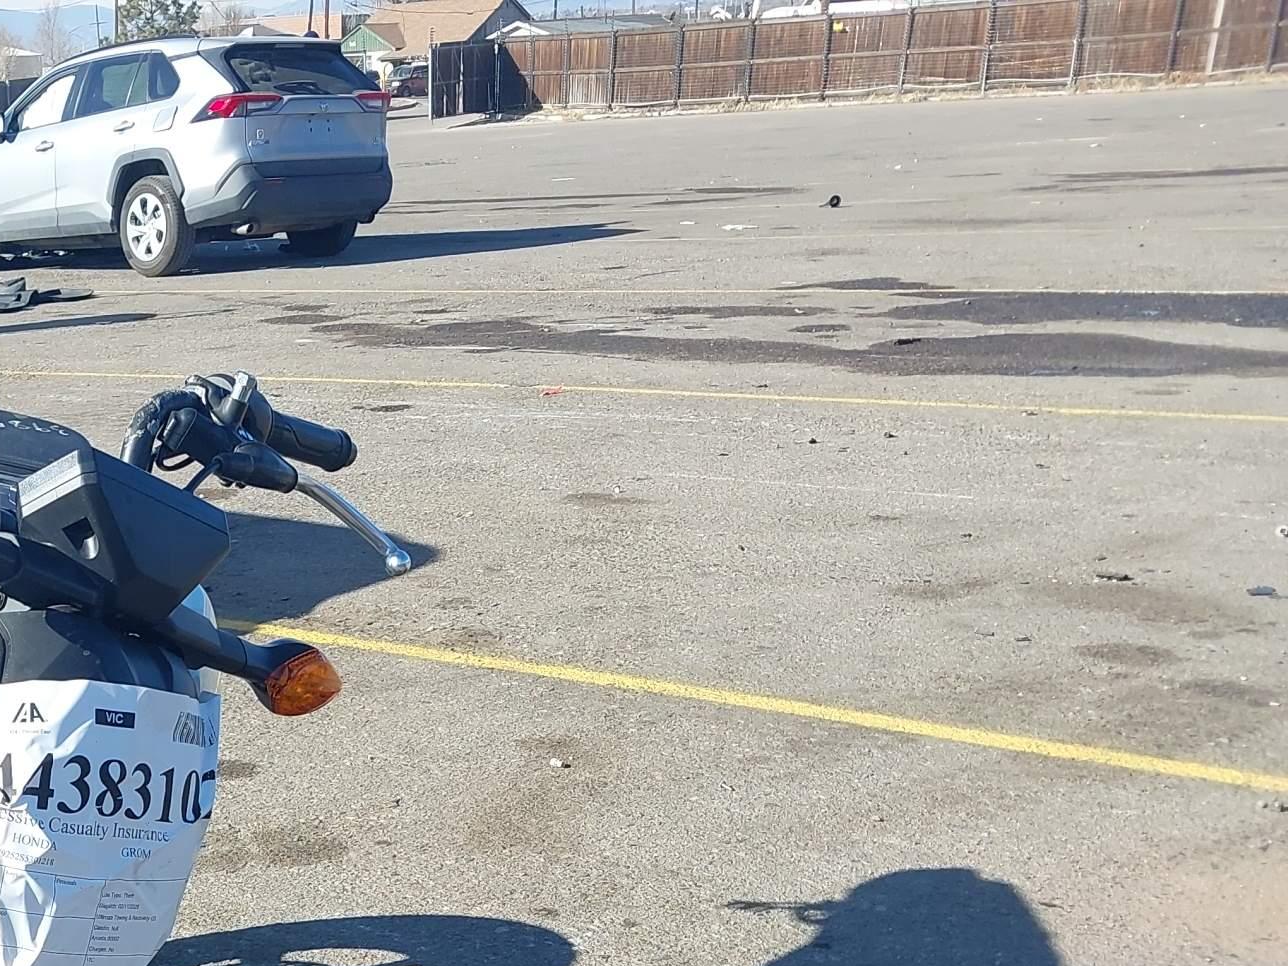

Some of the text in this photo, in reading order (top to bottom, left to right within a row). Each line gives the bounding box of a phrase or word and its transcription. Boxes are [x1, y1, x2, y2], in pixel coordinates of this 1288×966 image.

[105, 711, 124, 724] VIC
[49, 816, 109, 841] Casualty
[113, 822, 169, 843] Insurance
[13, 832, 151, 860] HONDA GROM
